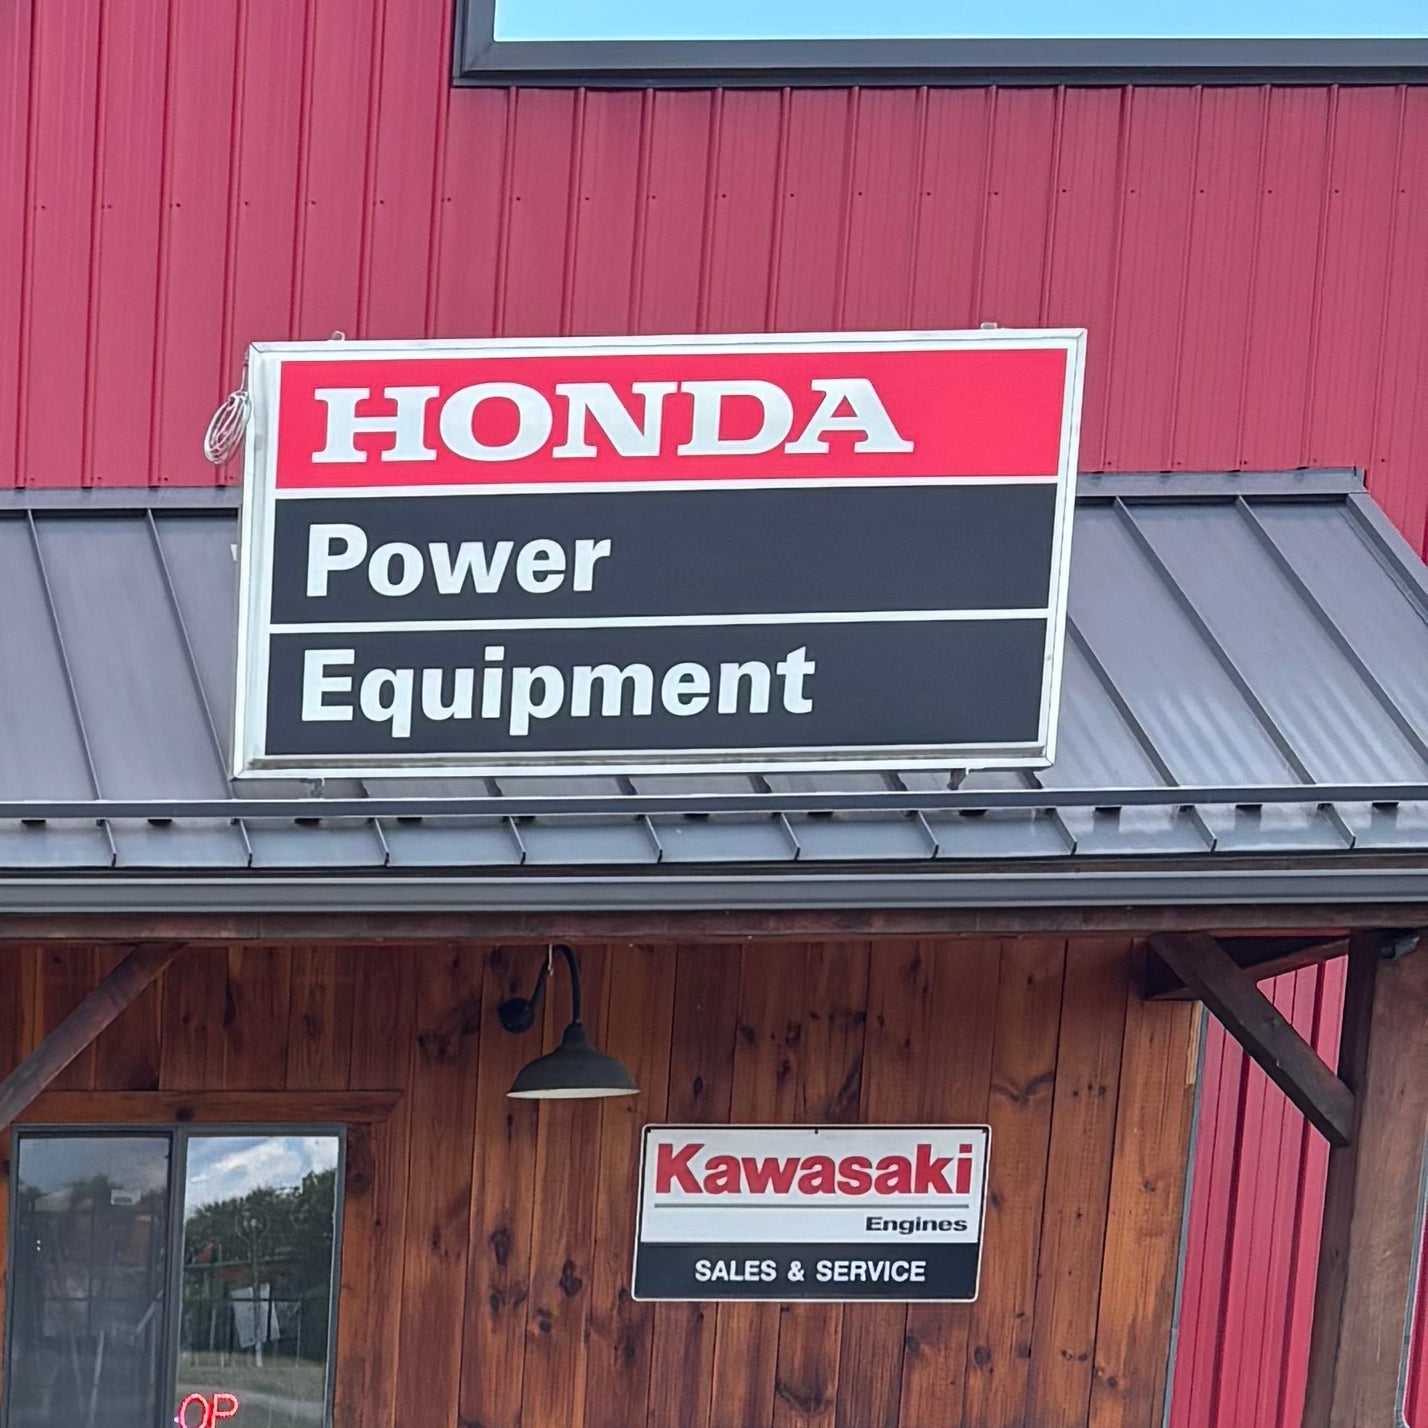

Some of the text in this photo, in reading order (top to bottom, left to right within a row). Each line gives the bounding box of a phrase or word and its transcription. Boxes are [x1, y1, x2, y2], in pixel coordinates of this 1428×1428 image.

[311, 378, 914, 464] HONDA
[305, 523, 611, 598] Power
[300, 646, 816, 739] Equipment
[655, 1143, 973, 1196] Kawasaki
[865, 1216, 968, 1235] Engines
[695, 1260, 927, 1283] SALES & SERVICE
